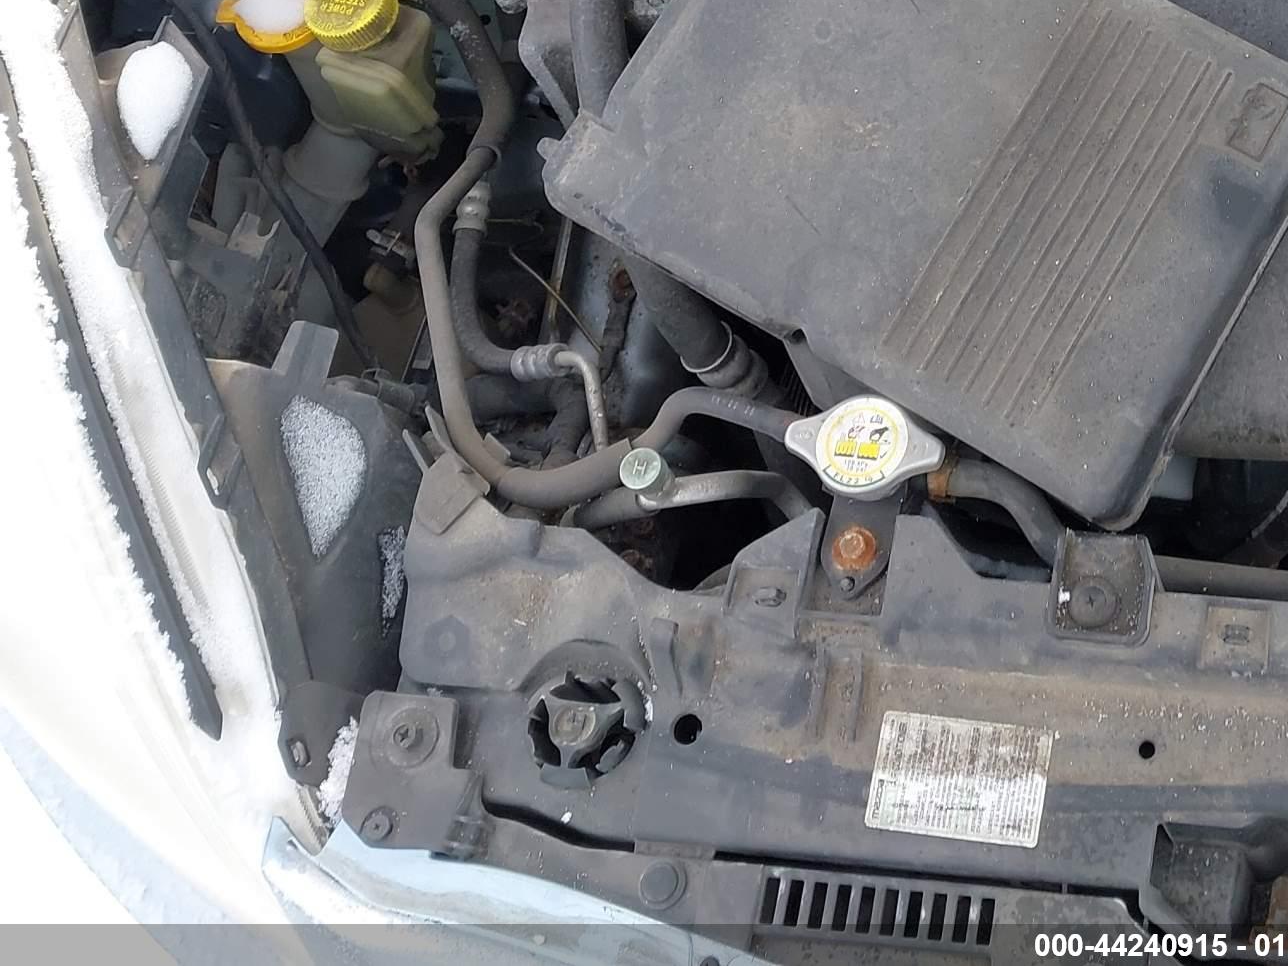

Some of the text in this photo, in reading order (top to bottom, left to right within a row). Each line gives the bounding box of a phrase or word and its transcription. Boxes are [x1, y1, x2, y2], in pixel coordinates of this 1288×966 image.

[320, 2, 354, 15] POWER
[633, 458, 648, 475] H
[871, 778, 885, 820] mazda
